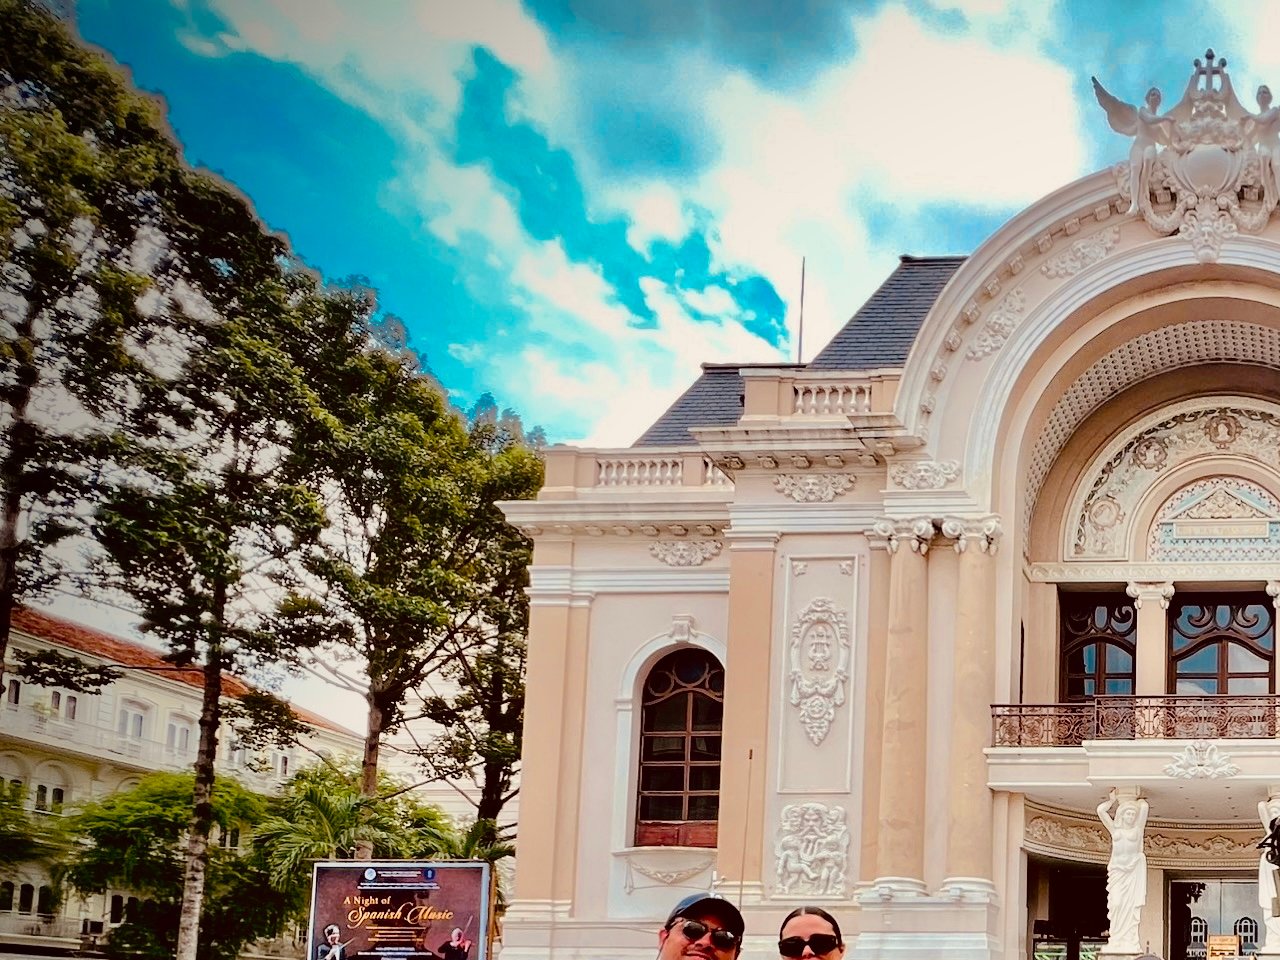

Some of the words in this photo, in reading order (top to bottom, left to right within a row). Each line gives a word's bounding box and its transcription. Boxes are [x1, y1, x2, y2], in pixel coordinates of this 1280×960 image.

[343, 896, 352, 905] A
[353, 896, 379, 907] Night
[381, 896, 391, 905] of
[347, 902, 412, 929] Spanish
[404, 903, 453, 924] Music
